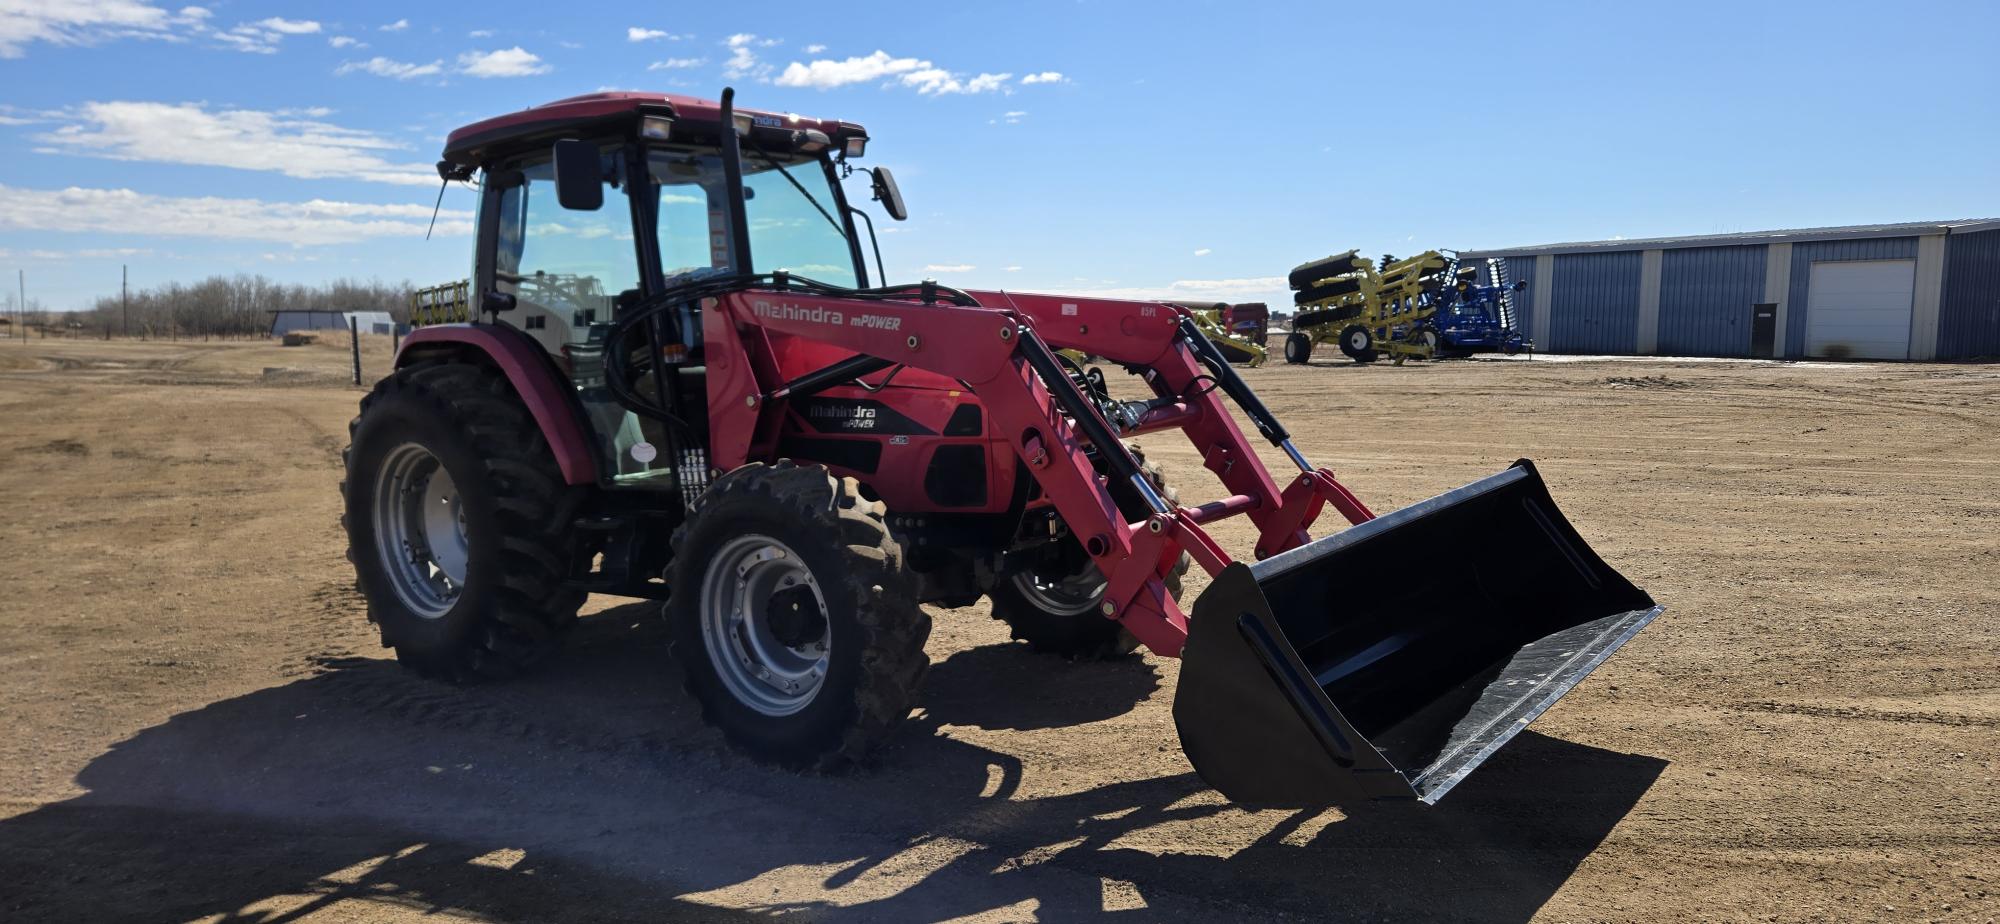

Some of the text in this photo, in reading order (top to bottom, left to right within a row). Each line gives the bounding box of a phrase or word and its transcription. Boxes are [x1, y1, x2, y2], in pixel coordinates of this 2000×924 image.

[754, 300, 901, 331] Mahindra mPOWER
[810, 406, 876, 418] Mahindra
